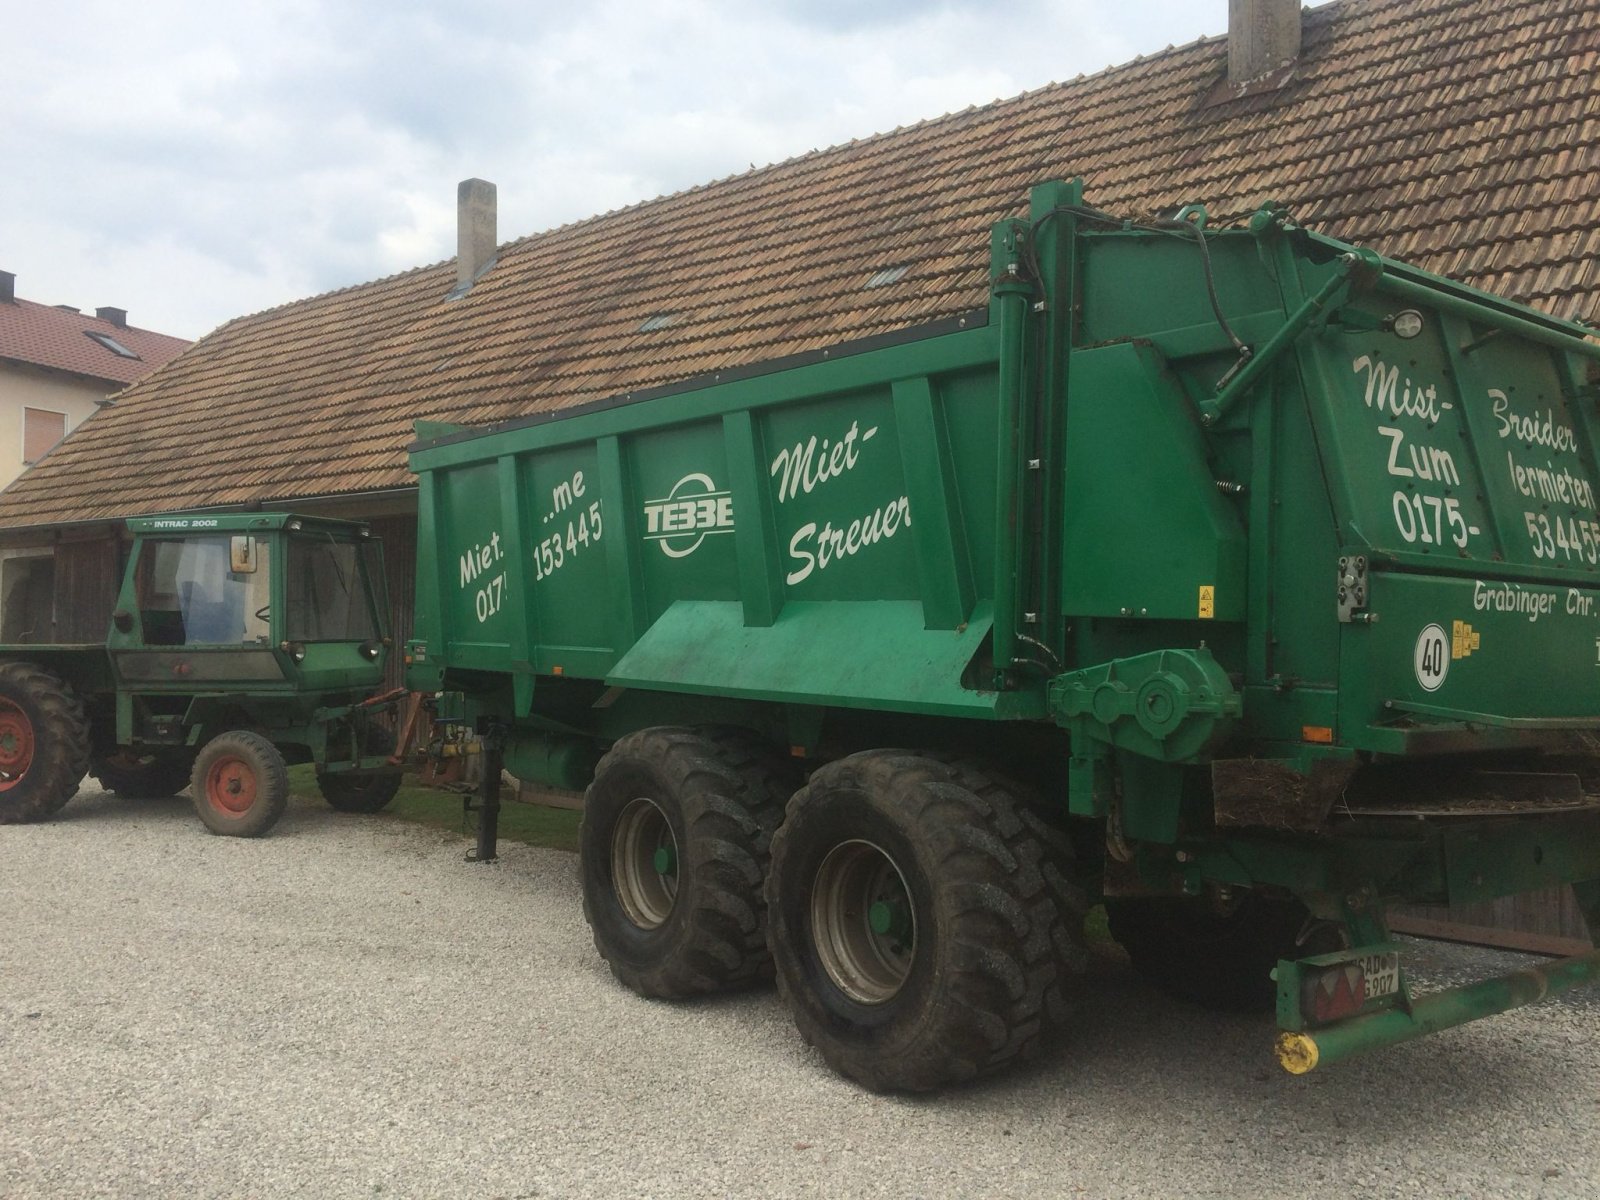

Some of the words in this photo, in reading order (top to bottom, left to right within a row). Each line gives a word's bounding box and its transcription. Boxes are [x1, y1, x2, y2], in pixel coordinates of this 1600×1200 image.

[1353, 355, 1453, 423] Mist-
[771, 420, 878, 503] Miet-
[1377, 425, 1460, 486] Zum
[154, 519, 189, 529] INTRAC
[191, 519, 218, 528] 2002
[644, 497, 735, 533] TEBBE
[786, 495, 912, 586] Streuer
[1392, 491, 1481, 548] 0175-
[476, 571, 508, 623] 017
[533, 498, 604, 581] 153445
[1473, 579, 1557, 622] Grabinger
[1566, 587, 1597, 618] Chr.
[1421, 638, 1443, 677] 40
